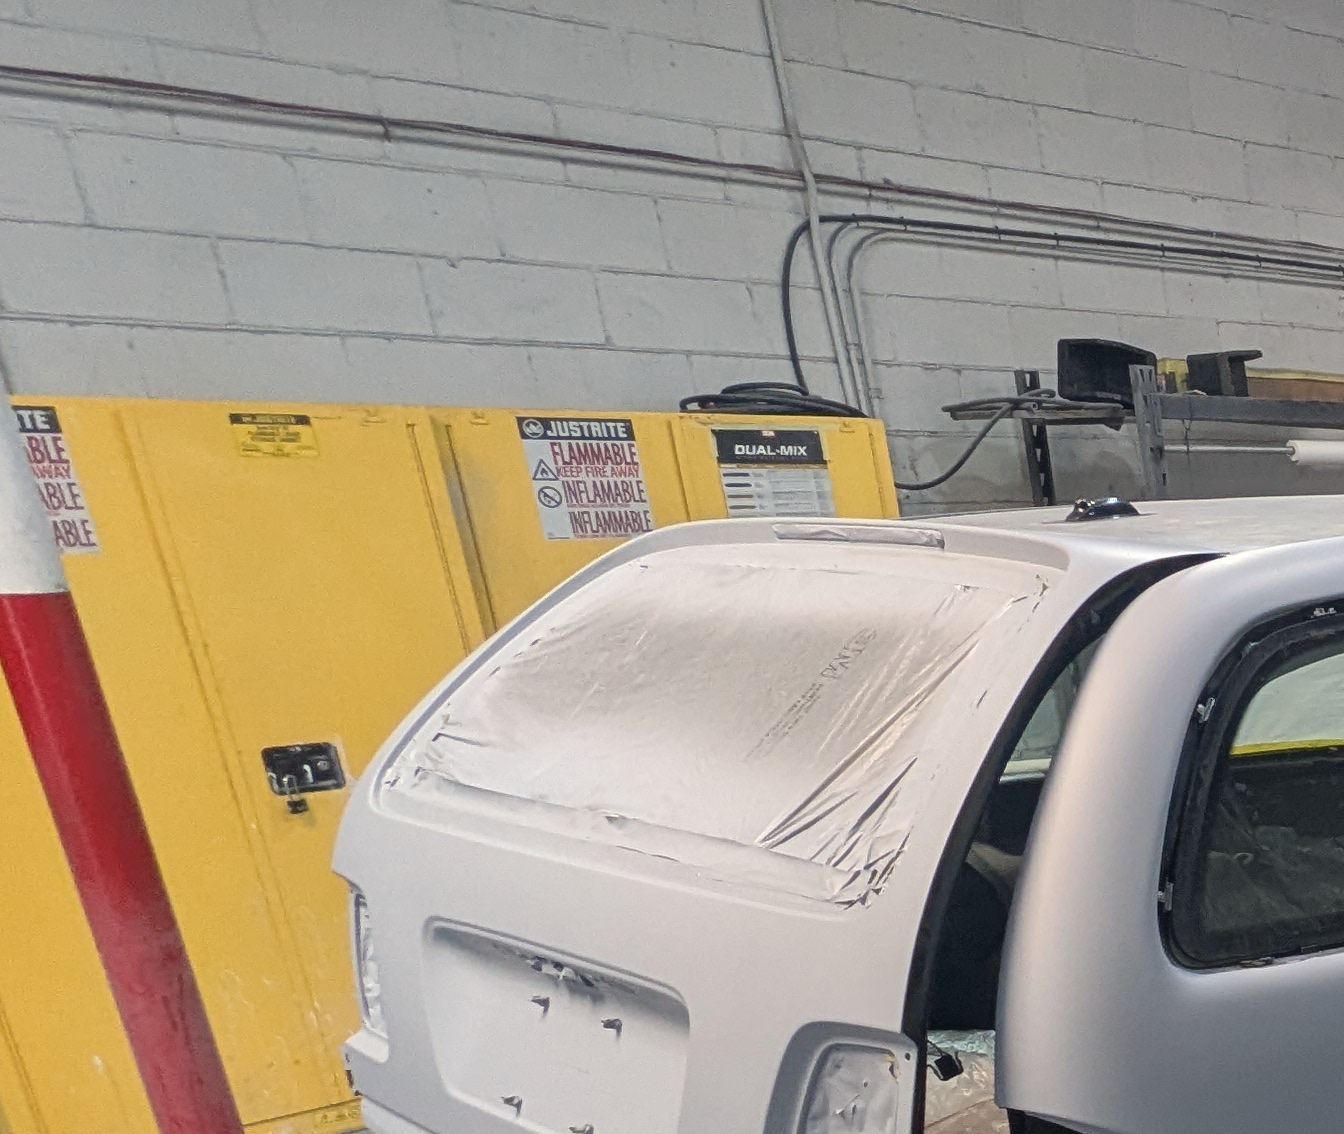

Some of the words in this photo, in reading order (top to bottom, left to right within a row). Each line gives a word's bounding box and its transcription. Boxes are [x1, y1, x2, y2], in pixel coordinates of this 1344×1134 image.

[546, 420, 628, 438] JUSTRITE
[549, 441, 640, 466] FLAMMABLE
[734, 444, 808, 457] DUAL-MIX
[555, 465, 583, 478] KEEP
[585, 465, 610, 478] FIRE
[610, 465, 641, 478] AWAY
[561, 480, 648, 504] INFLAMABLE
[568, 510, 655, 535] INFLAMMABLE
